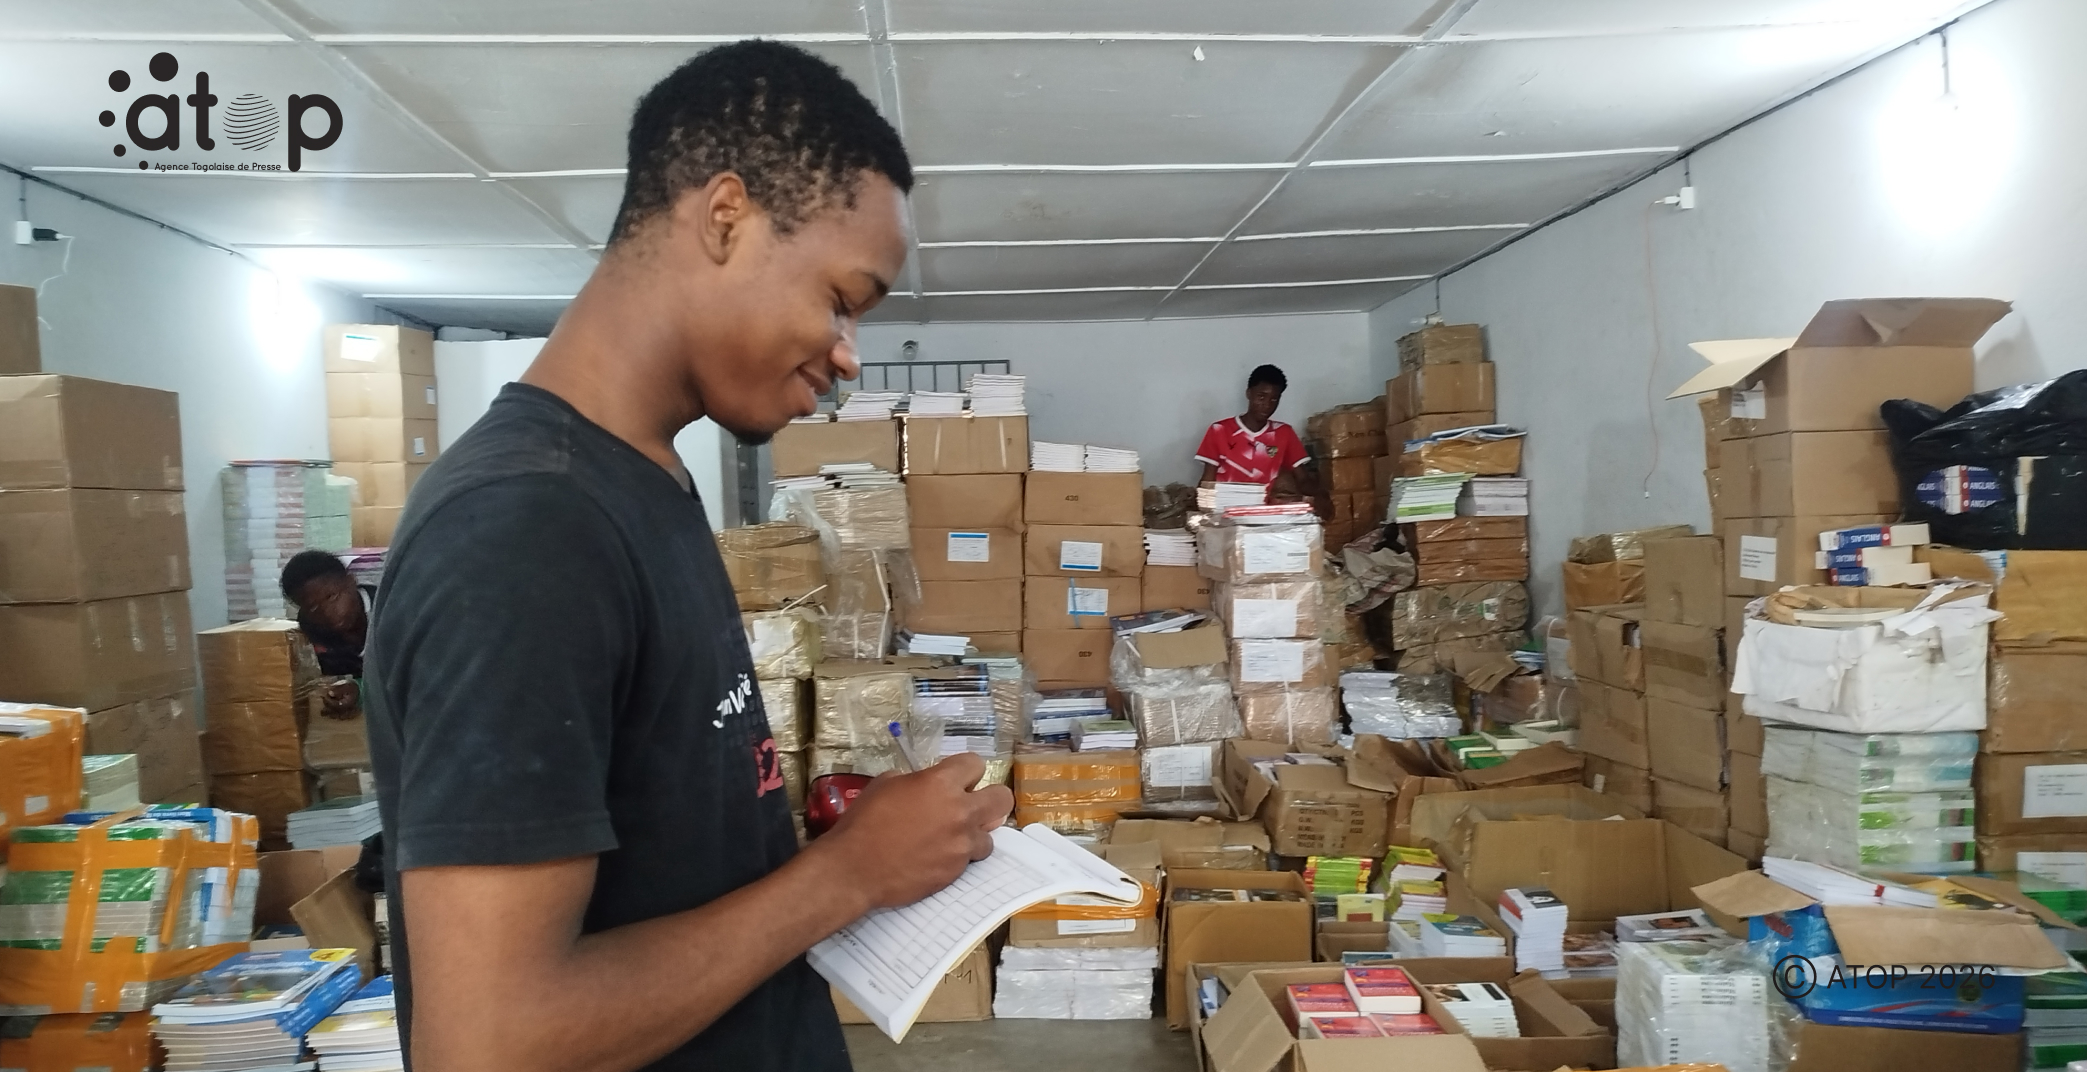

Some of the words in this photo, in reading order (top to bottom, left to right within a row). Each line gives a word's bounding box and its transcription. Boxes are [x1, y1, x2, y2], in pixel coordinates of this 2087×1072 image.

[1969, 481, 1996, 490] ANGLAIS
[1850, 533, 1881, 543] ANGLAIS
[1835, 554, 1857, 563] ANGLAIS
